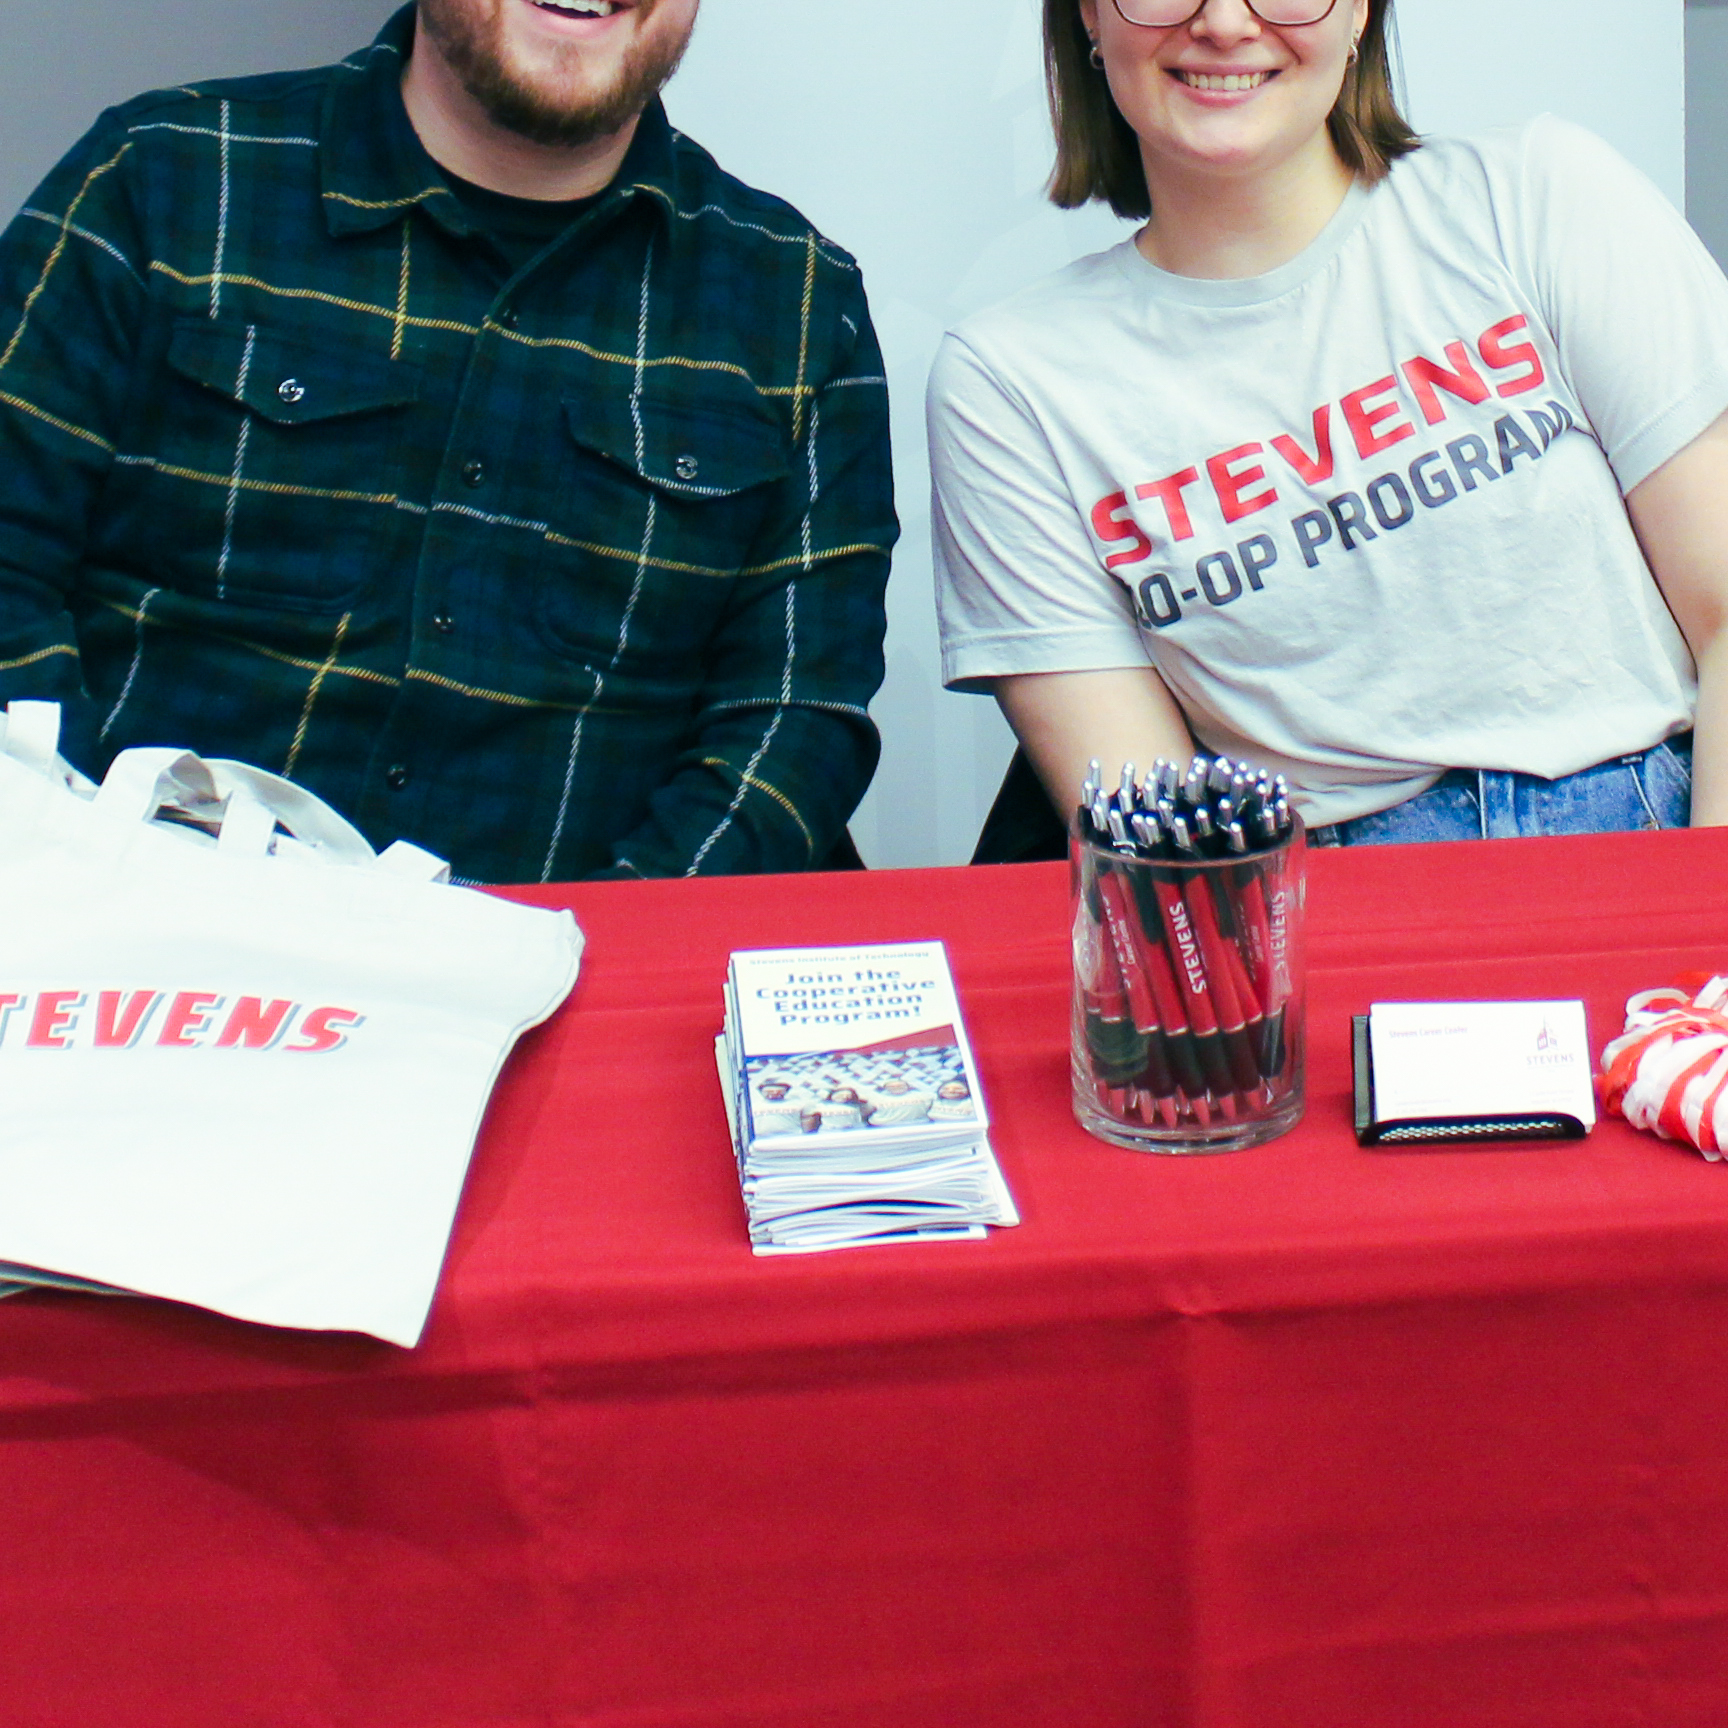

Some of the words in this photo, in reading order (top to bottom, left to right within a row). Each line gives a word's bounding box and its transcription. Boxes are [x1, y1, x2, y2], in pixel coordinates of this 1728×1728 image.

[1091, 314, 1545, 569] STEVENS
[1292, 401, 1573, 569] PROGRAM
[1169, 901, 1207, 994] STEVENS
[785, 971, 843, 985] Join
[853, 969, 901, 982] the
[755, 979, 936, 1000] Cooperative
[773, 993, 923, 1013] Education
[780, 1004, 922, 1026] Program!
[1526, 1053, 1574, 1066] STEVENS
